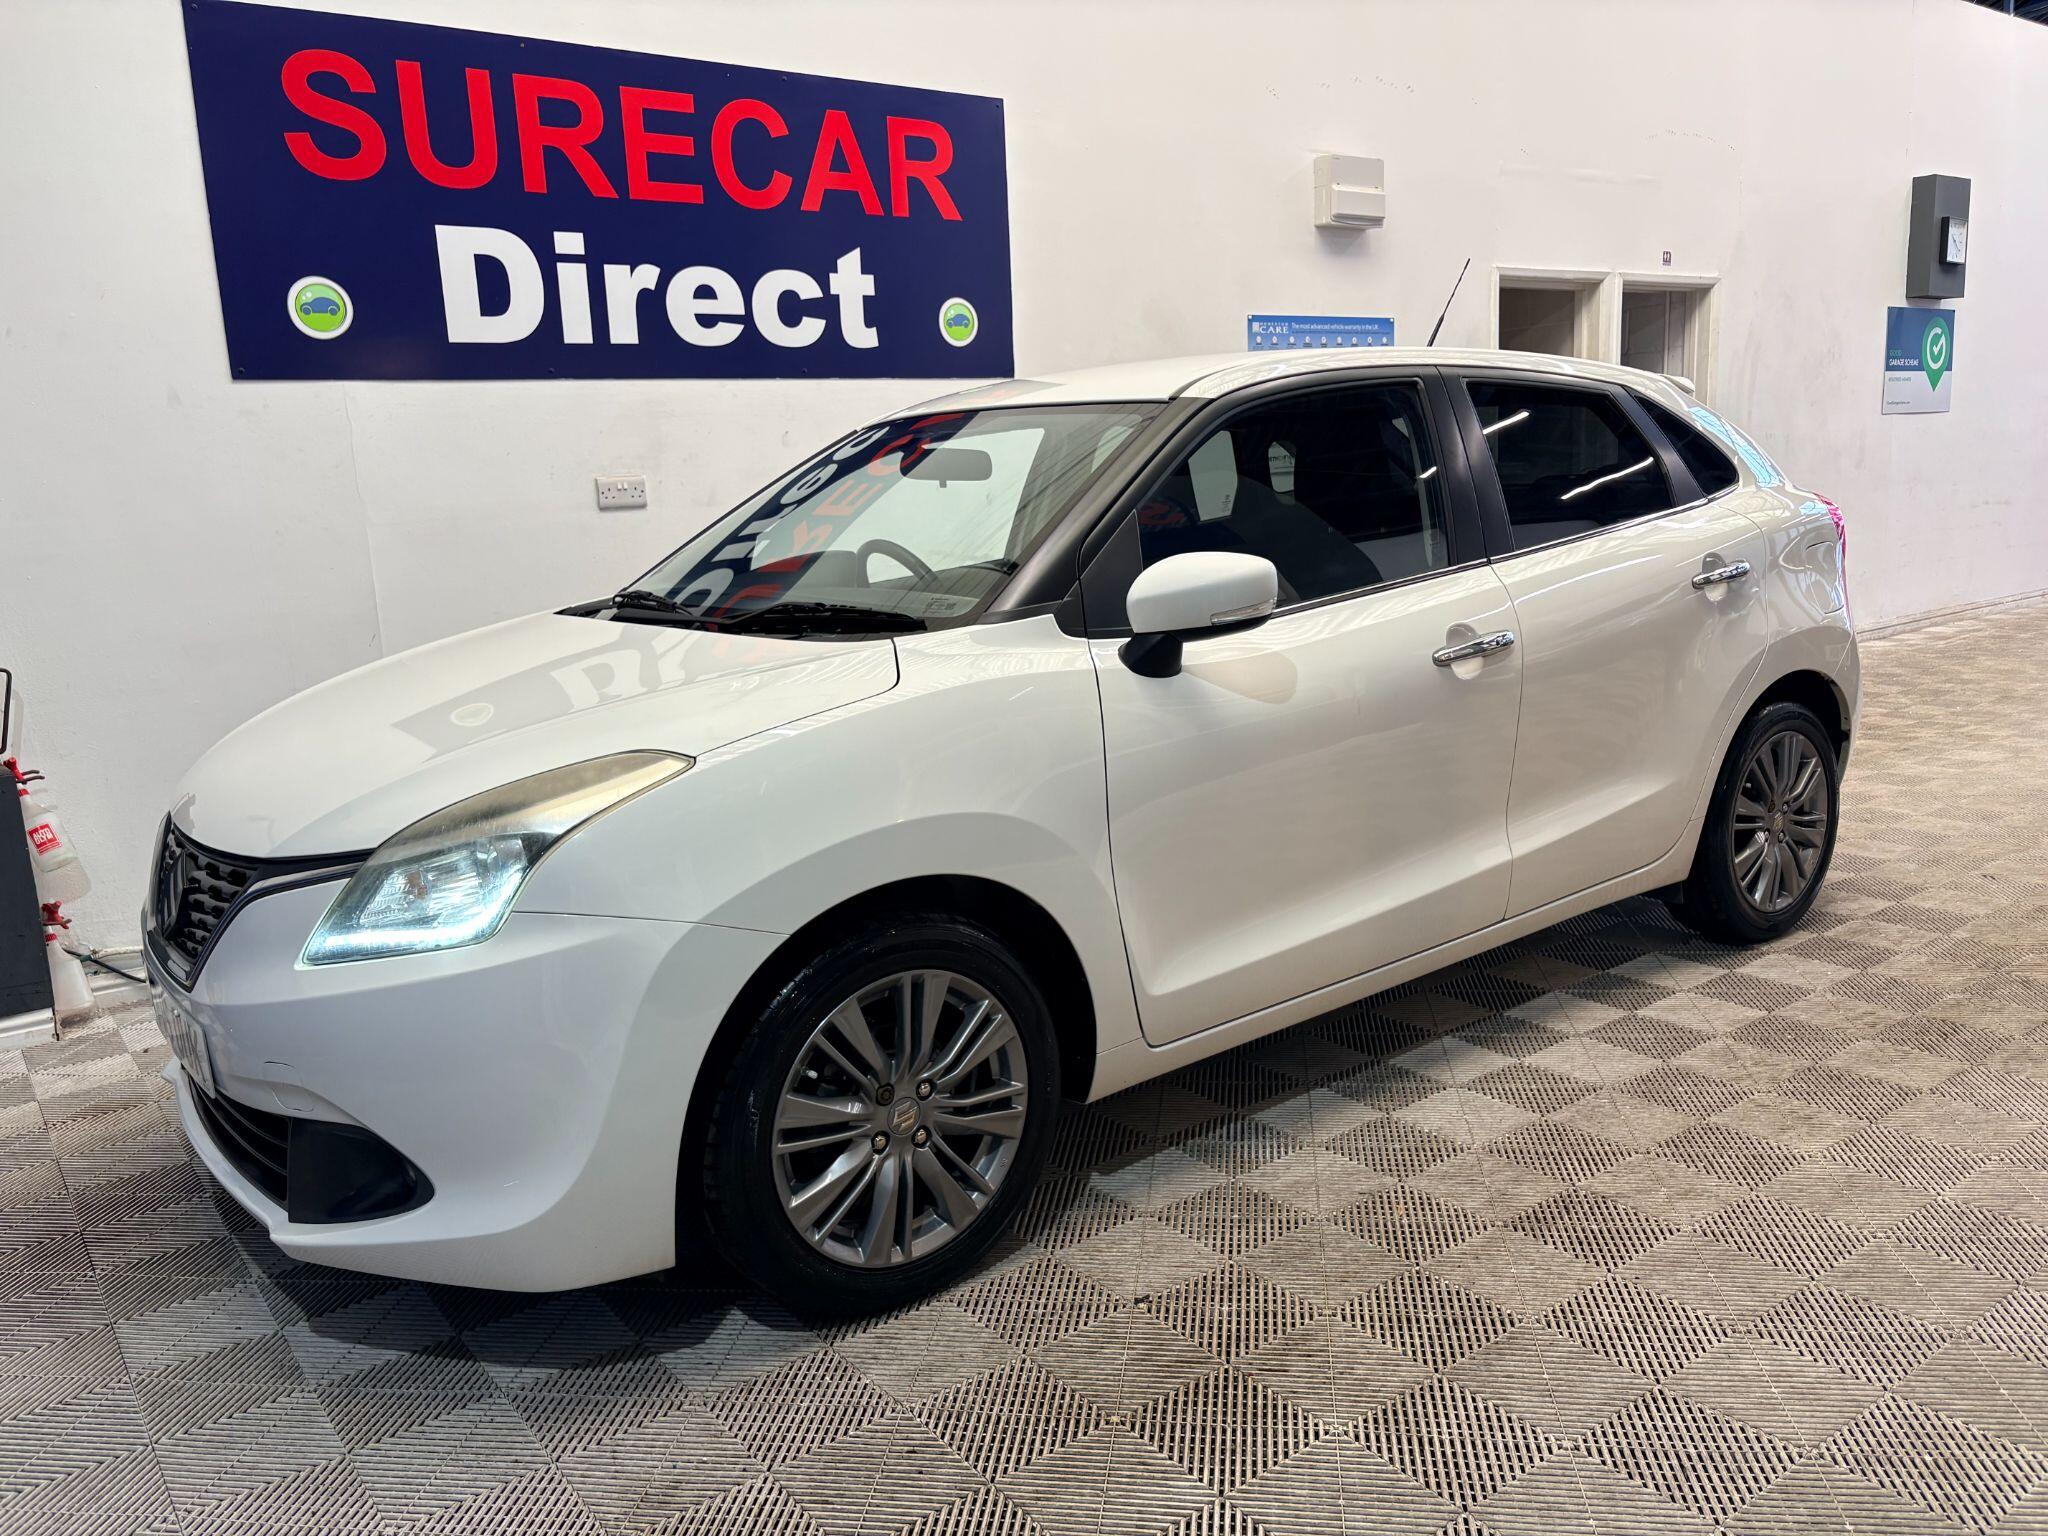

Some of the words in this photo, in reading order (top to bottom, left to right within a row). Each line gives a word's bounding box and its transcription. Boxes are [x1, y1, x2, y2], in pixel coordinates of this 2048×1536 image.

[281, 49, 963, 221] SURECAR
[435, 224, 880, 349] Direct
[1260, 326, 1289, 334] CARE
